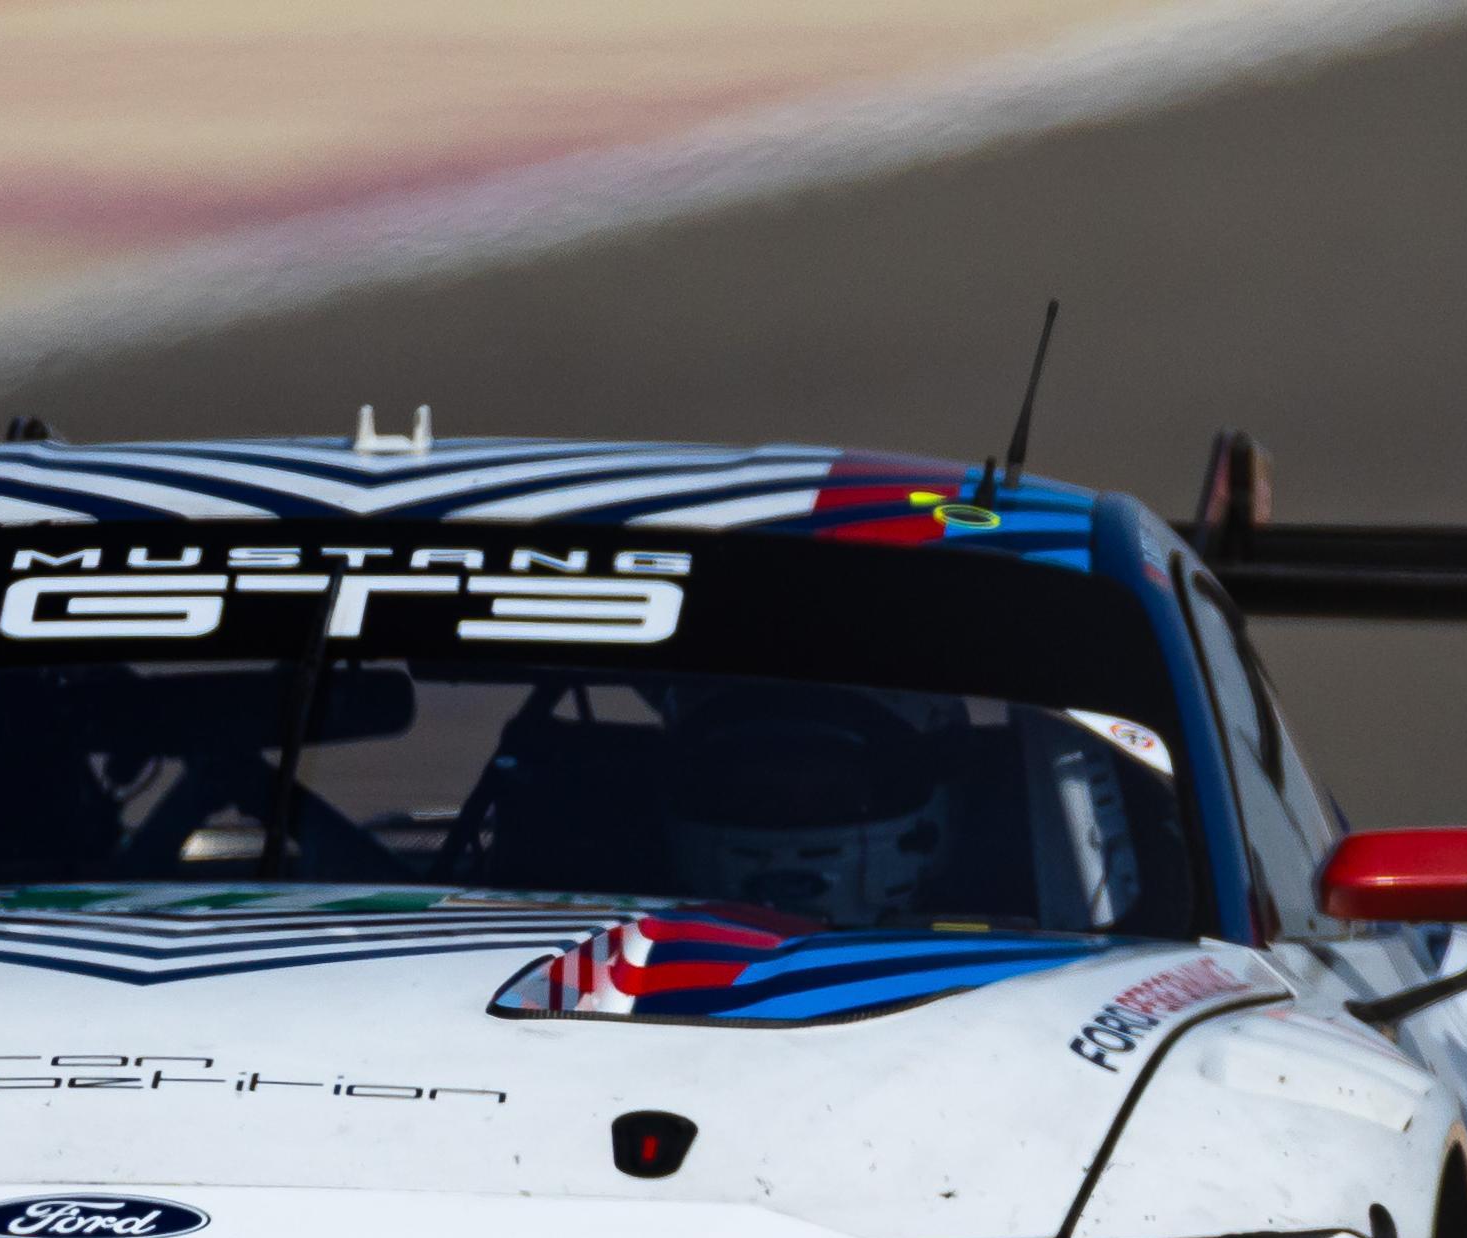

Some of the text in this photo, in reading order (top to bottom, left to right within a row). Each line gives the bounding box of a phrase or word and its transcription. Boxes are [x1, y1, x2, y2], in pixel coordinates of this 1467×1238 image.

[12, 547, 692, 575] MUSTANG
[0, 574, 685, 643] GT3
[7, 1198, 162, 1235] Ford
